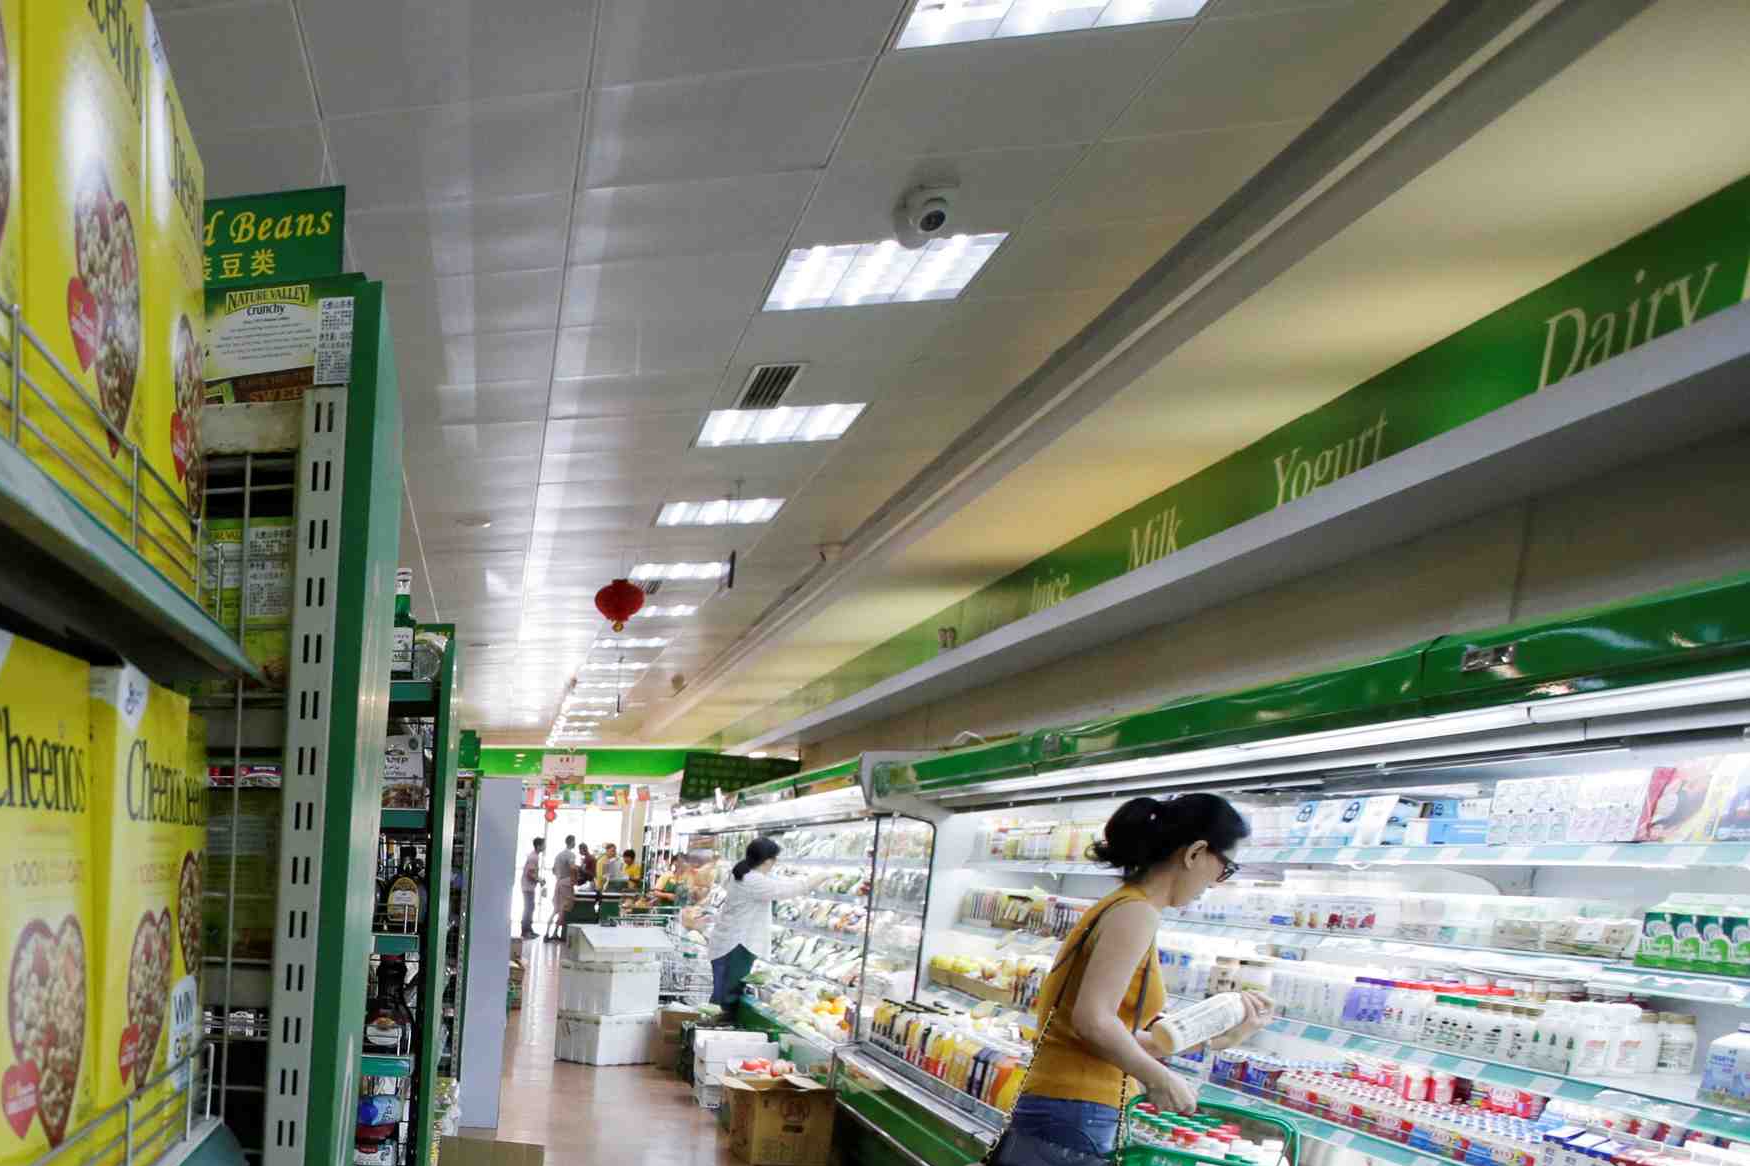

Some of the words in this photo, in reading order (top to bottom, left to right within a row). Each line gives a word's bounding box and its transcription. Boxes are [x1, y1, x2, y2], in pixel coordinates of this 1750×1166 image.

[230, 210, 333, 245] Beans
[270, 286, 308, 306] VALLEY
[1538, 260, 1719, 391] Dairy
[1272, 408, 1390, 508] Yogurt
[1128, 506, 1183, 571] Milk
